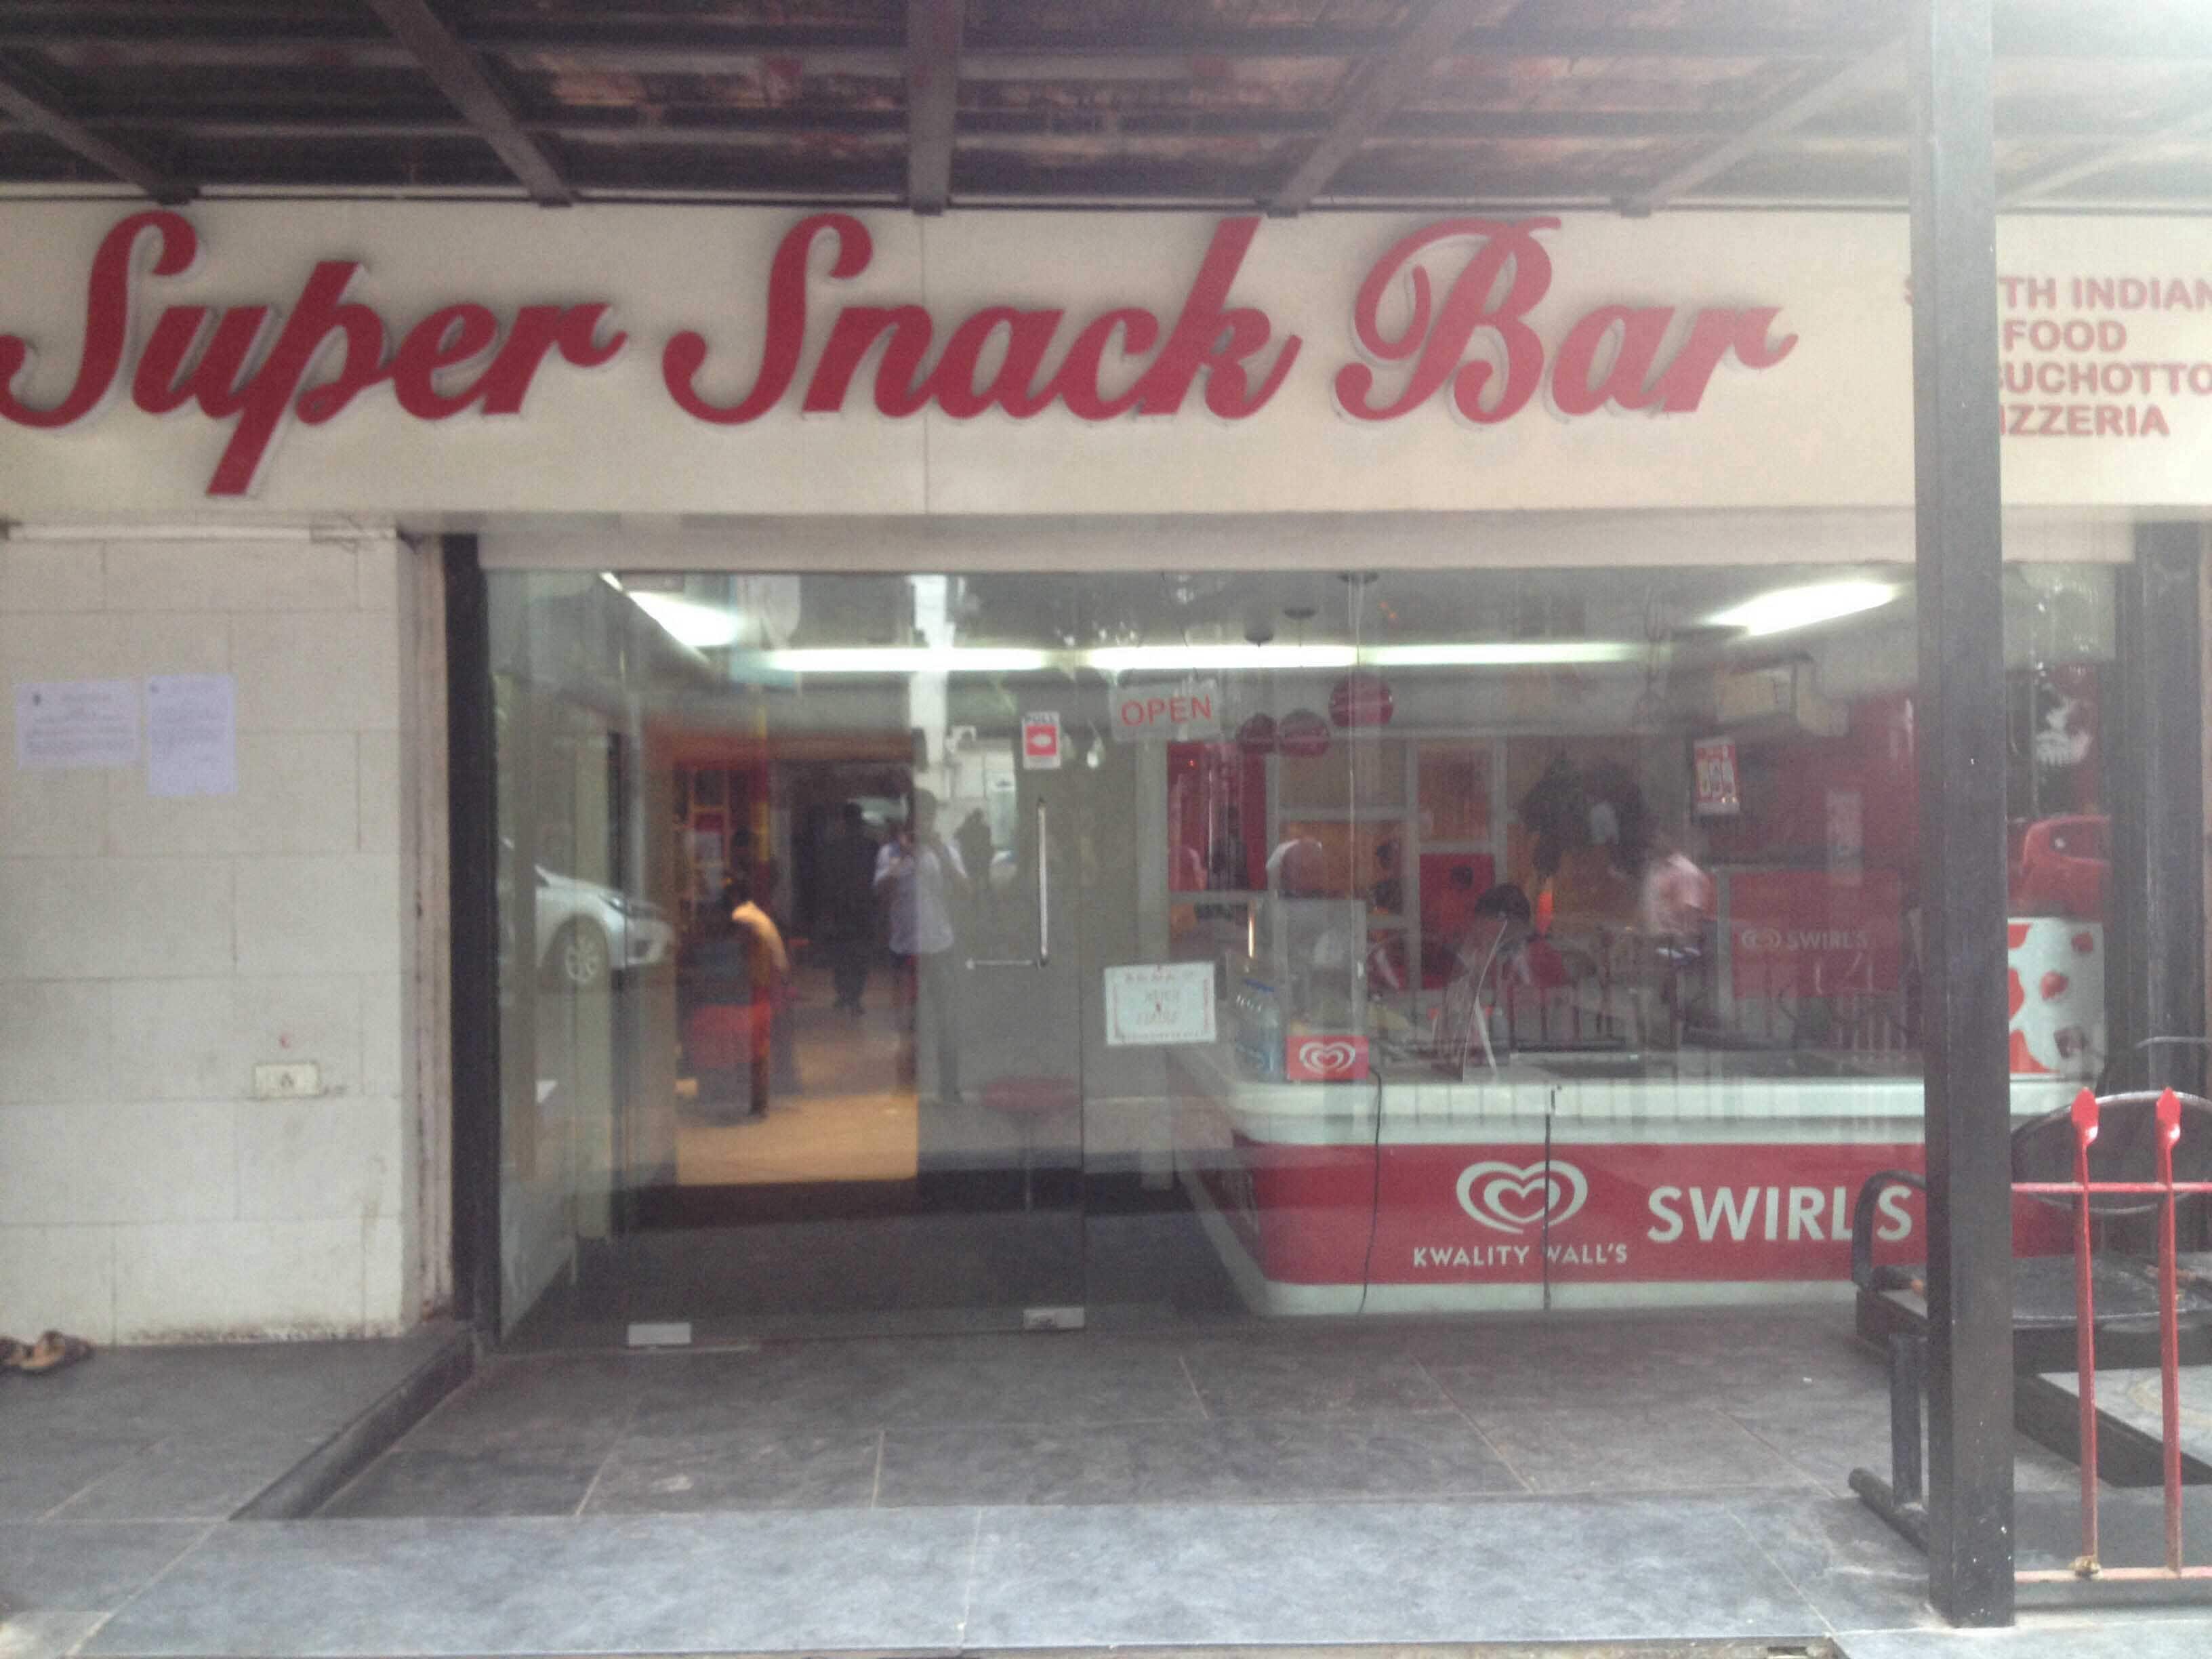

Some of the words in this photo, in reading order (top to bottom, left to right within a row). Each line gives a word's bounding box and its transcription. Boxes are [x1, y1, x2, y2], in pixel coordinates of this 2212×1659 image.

[2003, 320, 2127, 352] FOOD
[0, 211, 628, 495] Super
[662, 213, 1303, 425] Snack
[1334, 216, 1798, 426] Bar
[1999, 361, 2212, 394] UCHOTTO
[1120, 694, 1212, 726] OPEN
[1647, 1185, 1912, 1242] SWIRLS
[1414, 1245, 1530, 1267] KWALITY
[1544, 1243, 1627, 1264] WALL'S
